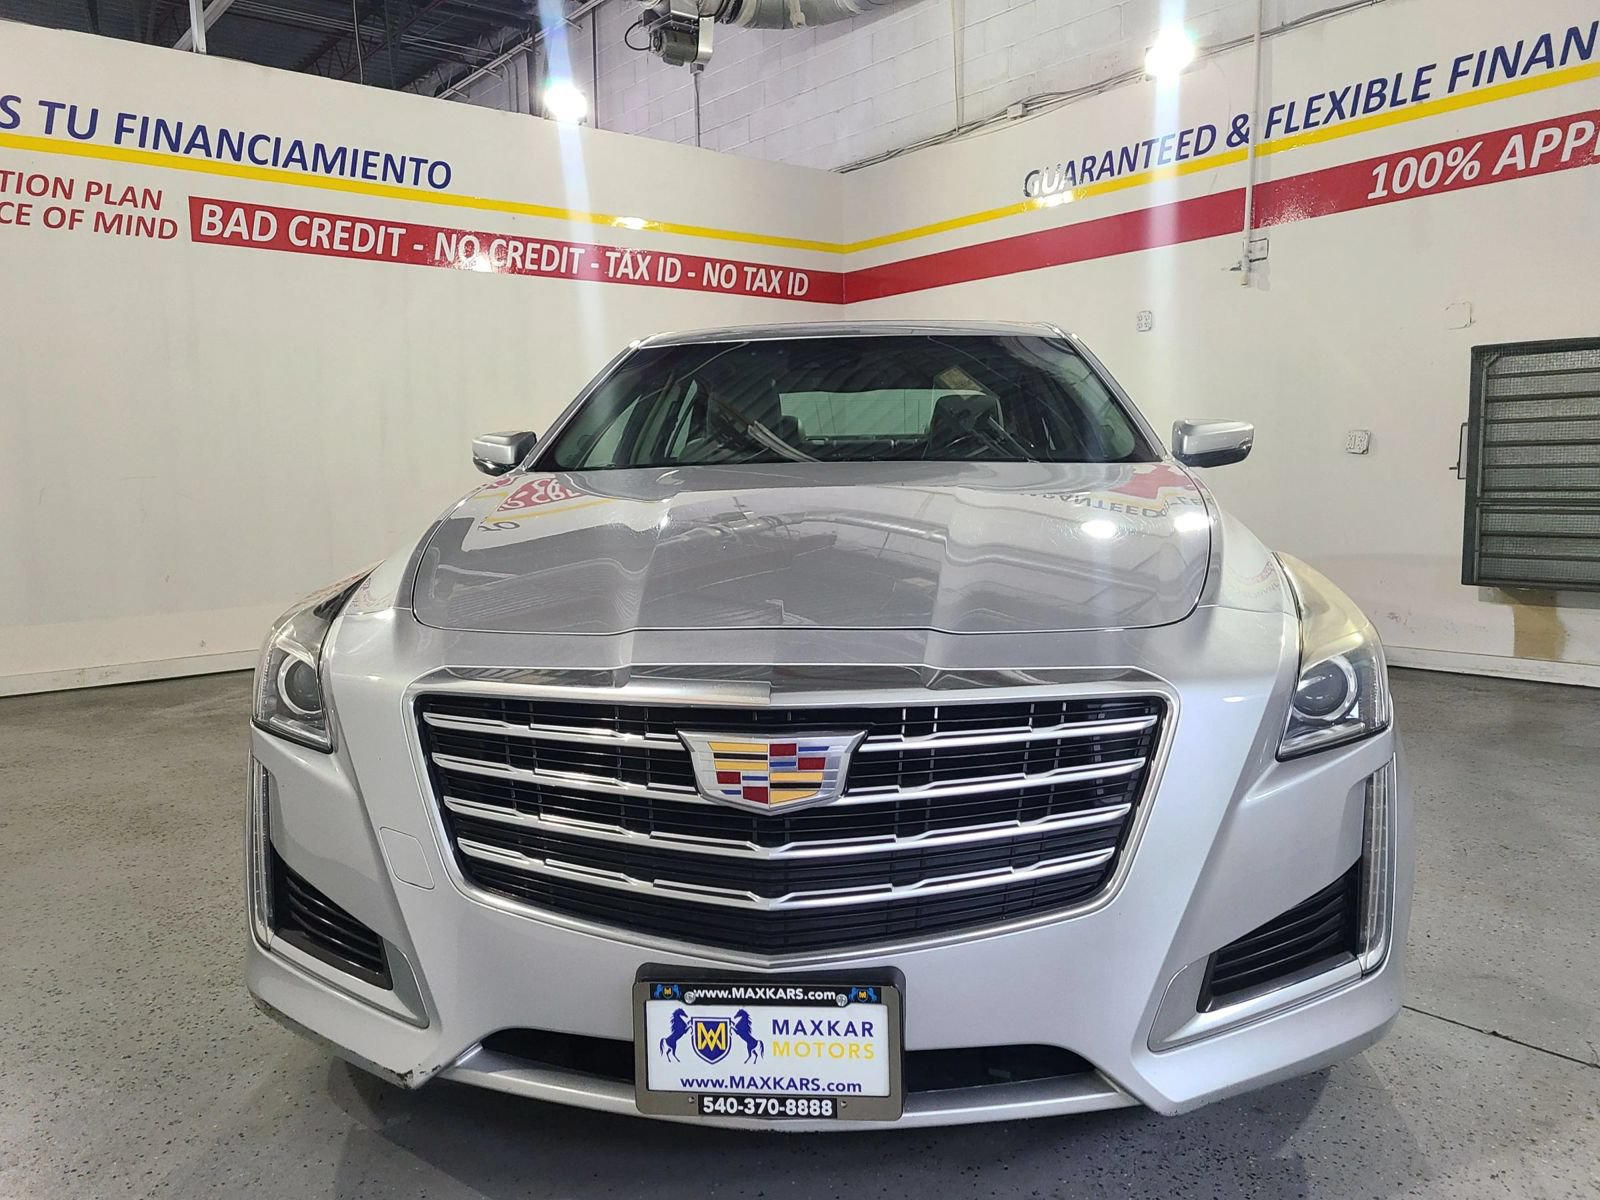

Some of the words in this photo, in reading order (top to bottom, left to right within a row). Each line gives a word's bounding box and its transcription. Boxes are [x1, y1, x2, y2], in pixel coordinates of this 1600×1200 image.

[1023, 124, 1217, 197] GUARANTEED
[1226, 113, 1250, 148] &
[1264, 64, 1437, 139] FLEXIBLE
[1447, 20, 1600, 94] FINAN
[38, 100, 99, 140] TU
[114, 112, 452, 190] FINANCIAMIENTO
[1367, 141, 1484, 200] 100%
[1492, 120, 1600, 176] APP
[85, 180, 162, 211] PLAN
[43, 206, 85, 230] OF
[93, 211, 178, 240] MIND
[200, 204, 278, 242] BAD
[289, 215, 406, 258] CREDIT
[434, 232, 481, 263] NO
[488, 238, 585, 275] CREDIT
[605, 251, 649, 281] TAX
[657, 256, 682, 283] ID
[703, 261, 737, 289] NO
[744, 265, 782, 295] TAX
[788, 271, 809, 297] ID
[693, 987, 836, 1001] www.MAXKARS.com
[772, 1018, 874, 1038] MAXKAR
[772, 1040, 875, 1060] MOTORS
[680, 1075, 862, 1093] www.MAXKARS.com
[703, 1096, 833, 1116] 540-370-8888
